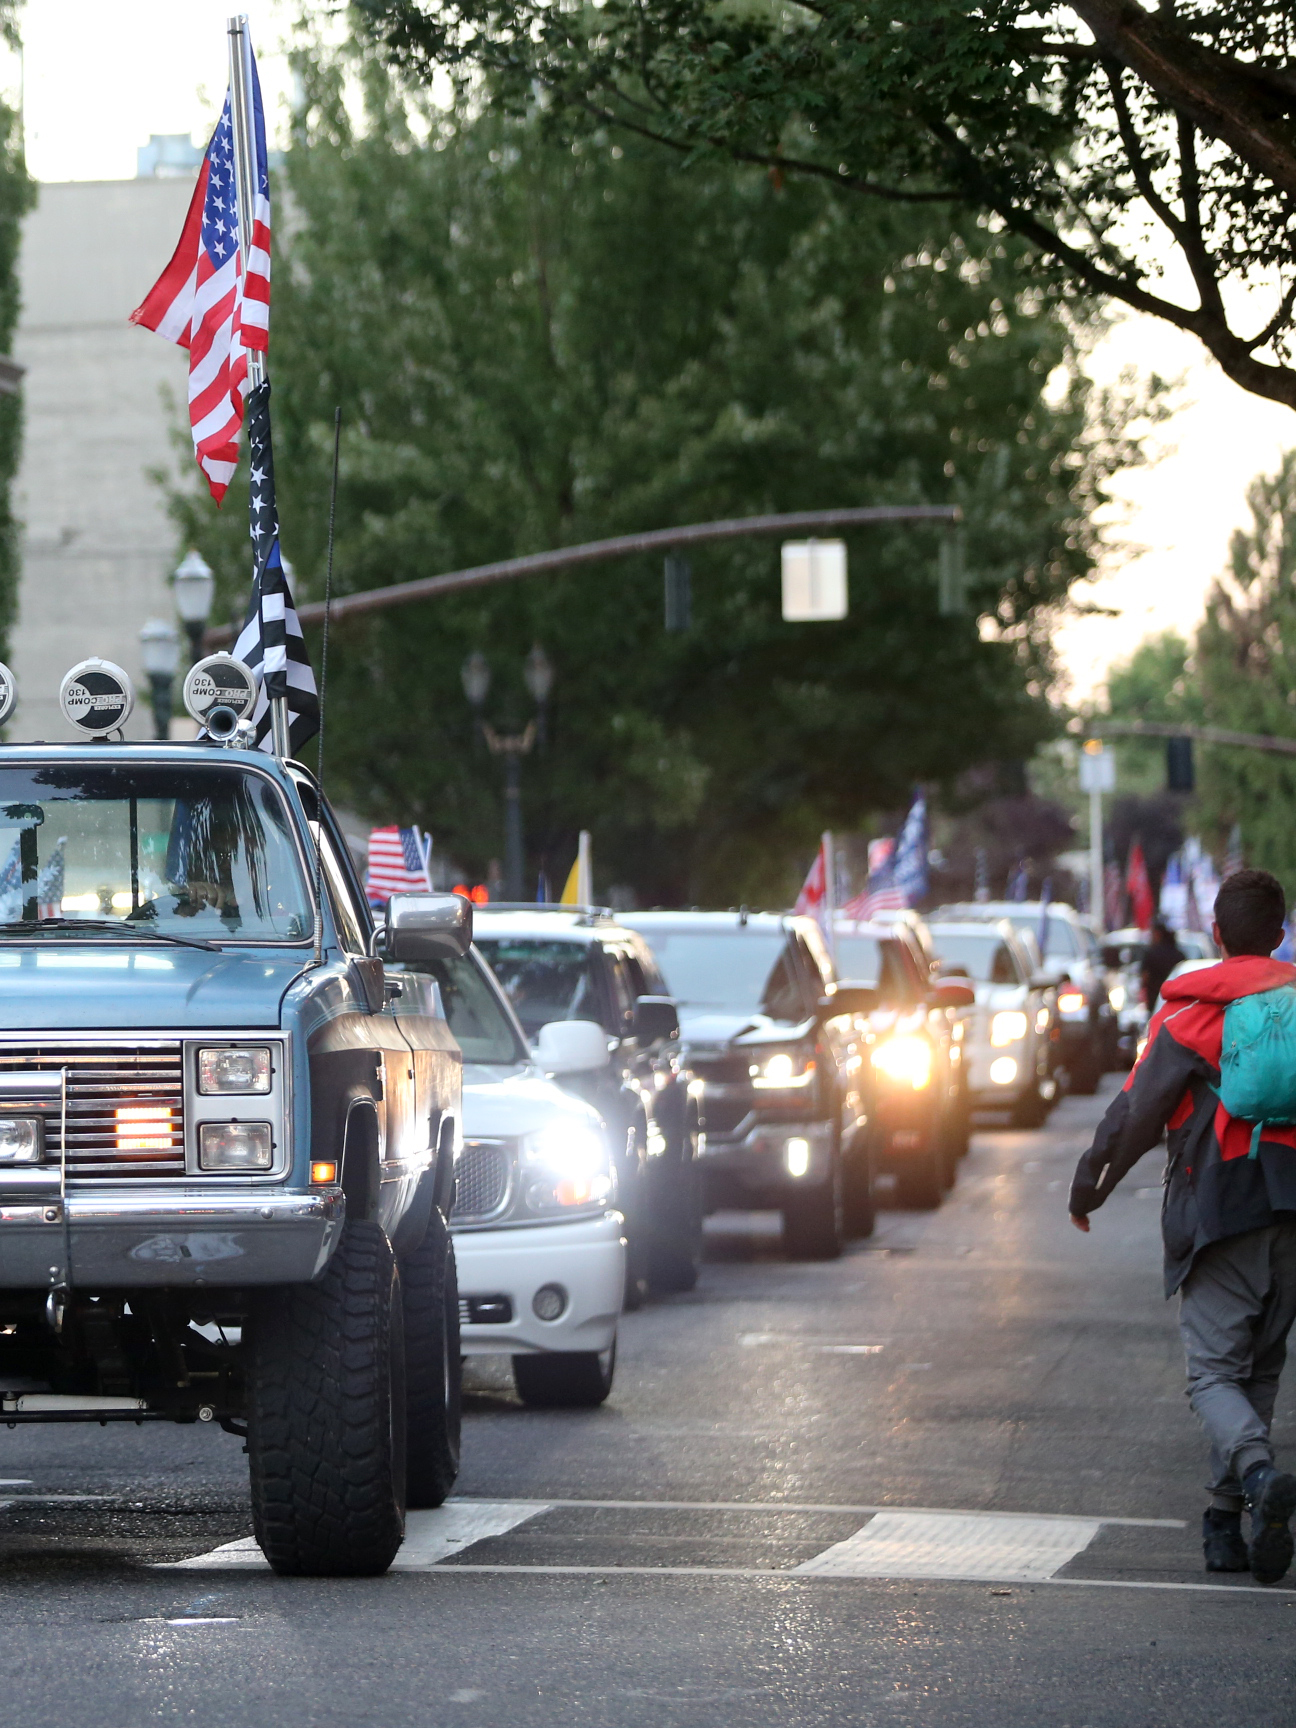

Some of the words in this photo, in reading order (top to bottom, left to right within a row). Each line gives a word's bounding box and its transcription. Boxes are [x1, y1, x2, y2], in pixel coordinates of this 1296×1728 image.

[194, 678, 212, 686] 130
[68, 689, 86, 697] 130
[192, 688, 222, 696] COMP
[225, 689, 247, 698] PRO
[68, 697, 98, 705] COMP
